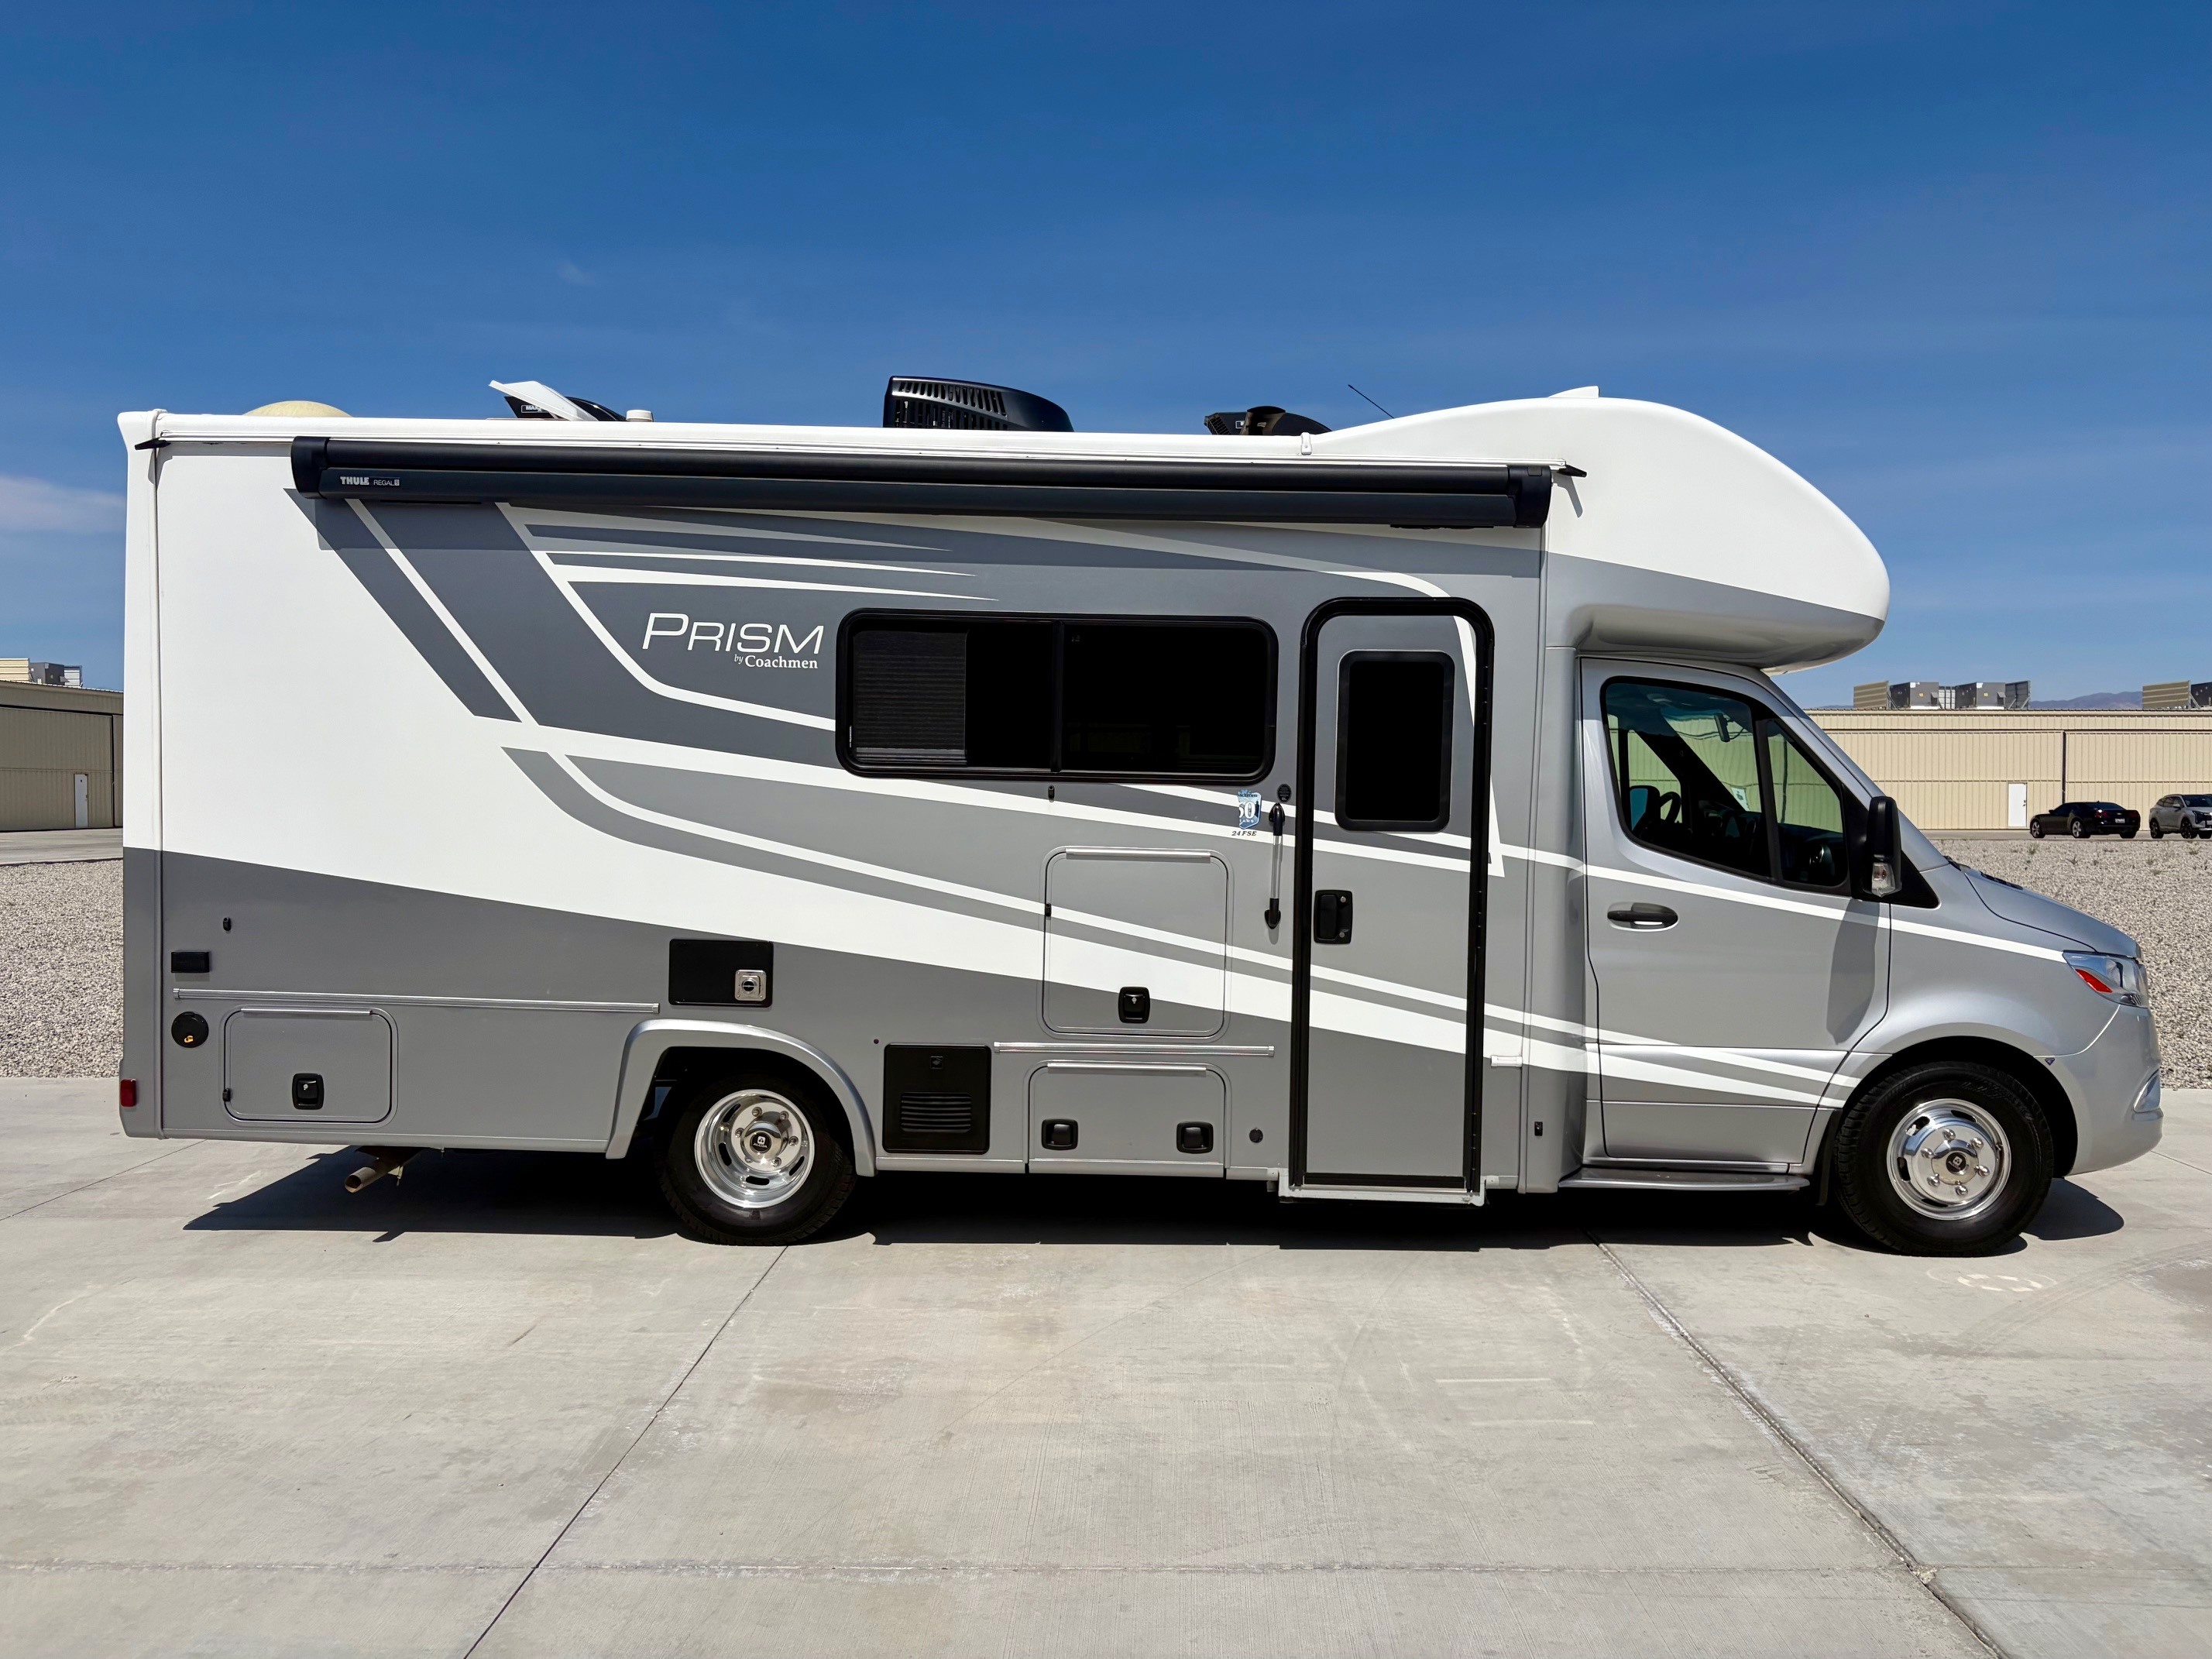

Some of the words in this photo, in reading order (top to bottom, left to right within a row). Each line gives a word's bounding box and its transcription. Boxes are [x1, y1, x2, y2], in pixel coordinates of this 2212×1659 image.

[340, 476, 369, 486] THULE
[642, 612, 824, 654] PRISM
[734, 654, 744, 665] by
[745, 654, 818, 668] Coachmen
